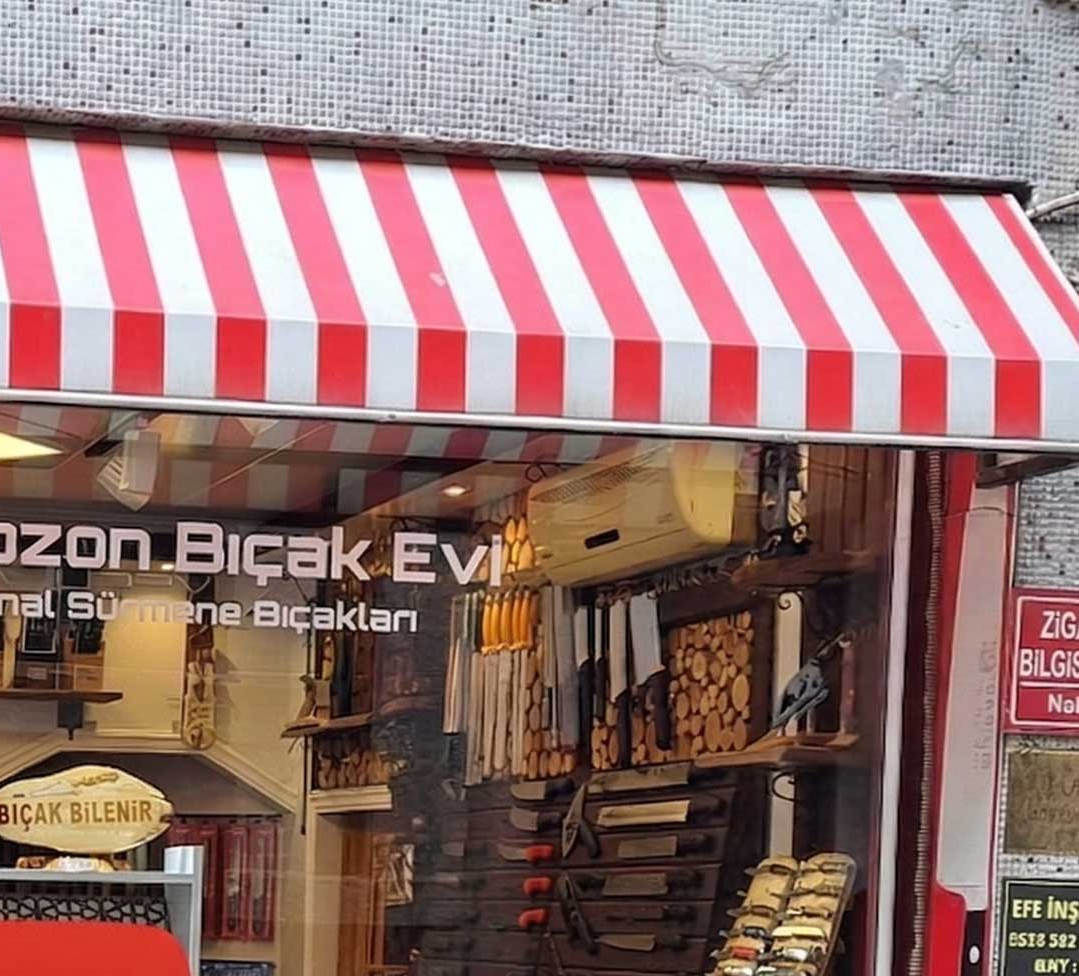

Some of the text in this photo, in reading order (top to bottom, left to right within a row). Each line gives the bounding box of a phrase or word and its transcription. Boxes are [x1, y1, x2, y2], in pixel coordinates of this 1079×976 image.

[174, 520, 372, 587] Bıçak
[1040, 610, 1079, 640] ZiG
[1012, 900, 1042, 919] EFE
